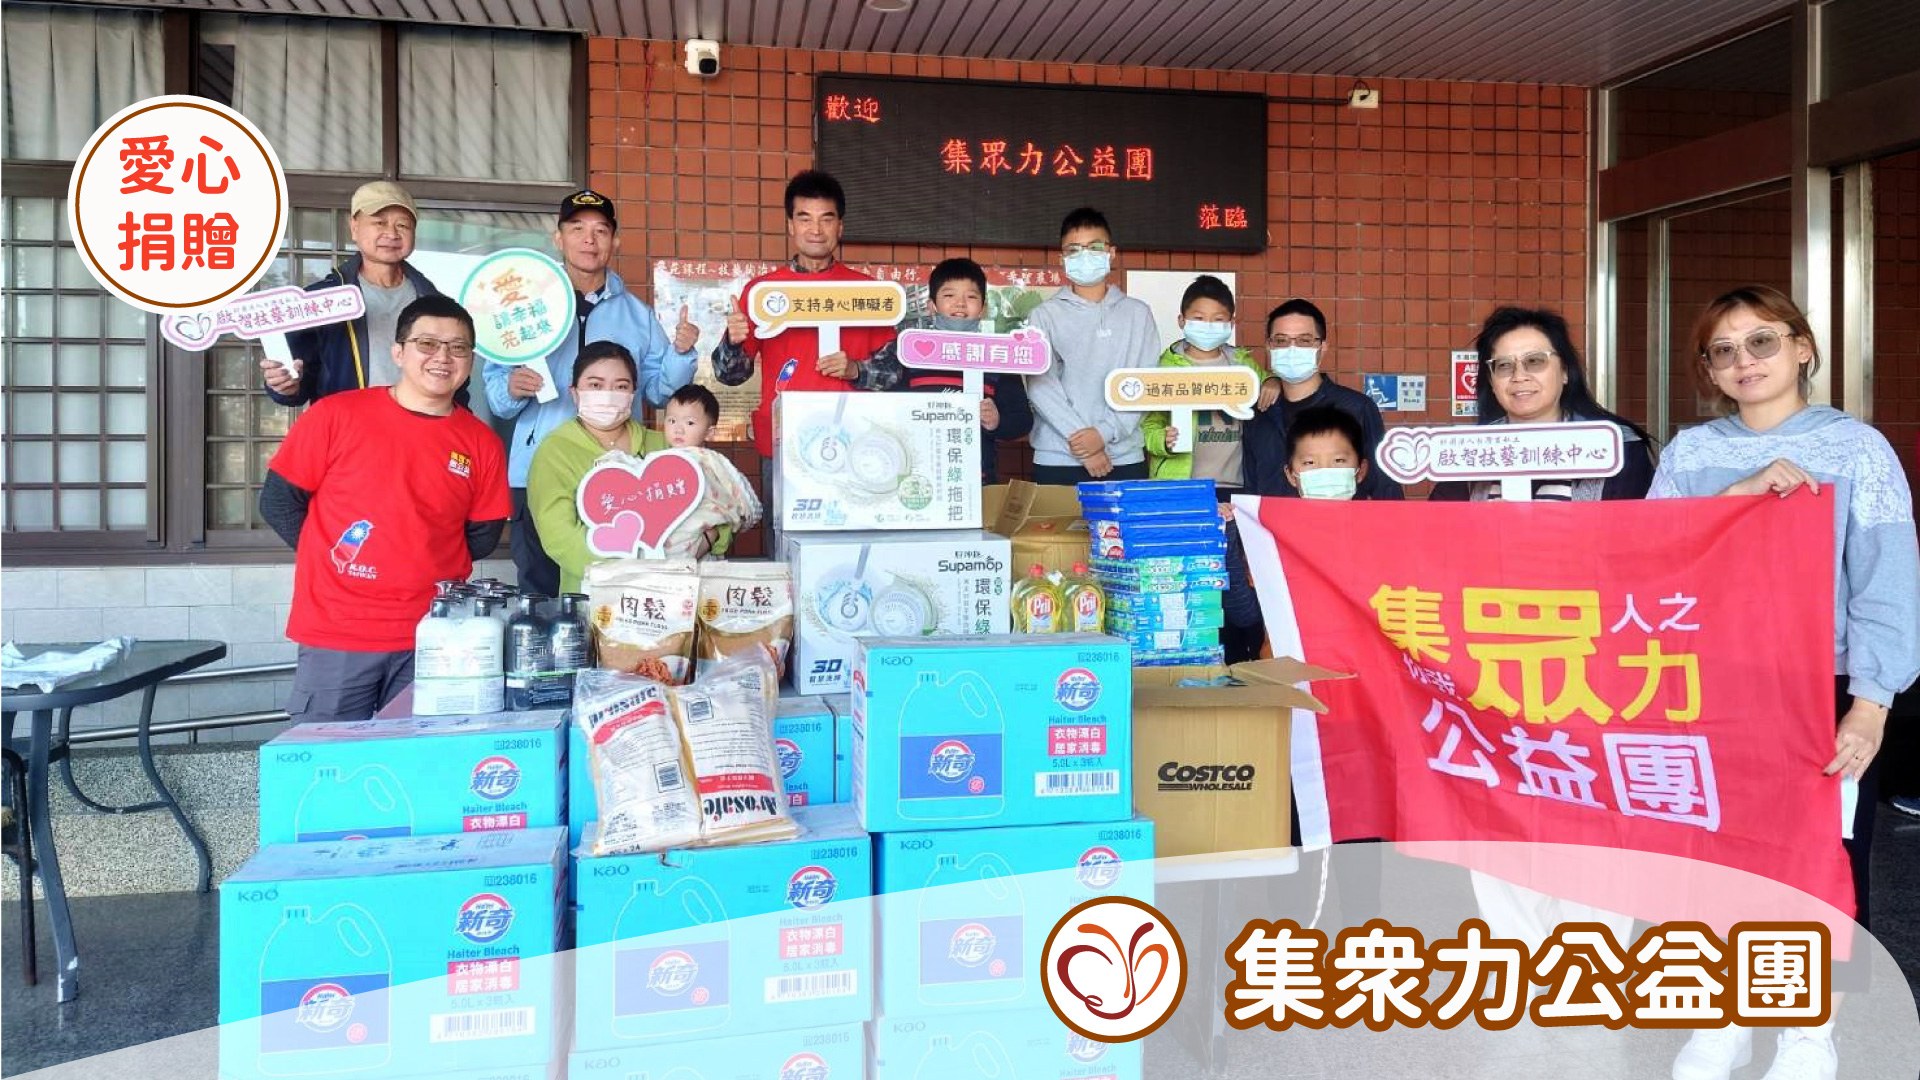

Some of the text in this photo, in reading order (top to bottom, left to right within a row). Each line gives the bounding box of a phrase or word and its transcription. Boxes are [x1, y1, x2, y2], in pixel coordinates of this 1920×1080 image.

[825, 95, 880, 123] 歡迎
[940, 138, 1155, 181] 集眾力公益團
[1200, 205, 1249, 230] 蒞臨
[492, 268, 528, 306] 愛
[493, 298, 548, 329] 讓幸福
[792, 297, 895, 313] 支持身心障礙者
[941, 341, 1034, 365] 感謝有您
[912, 408, 973, 424] Supamop
[1438, 443, 1608, 468] 啟智技藝訓練中心
[938, 557, 1003, 574] Supamop
[811, 658, 843, 673] 3D
[1055, 682, 1101, 701] 新奇
[929, 753, 976, 774] 新奇
[1421, 698, 1721, 832] 公益團
[470, 769, 521, 790] 新奇
[1189, 783, 1252, 791] WHOLESALE
[787, 879, 837, 901] 新奇
[456, 909, 513, 933] 新奇
